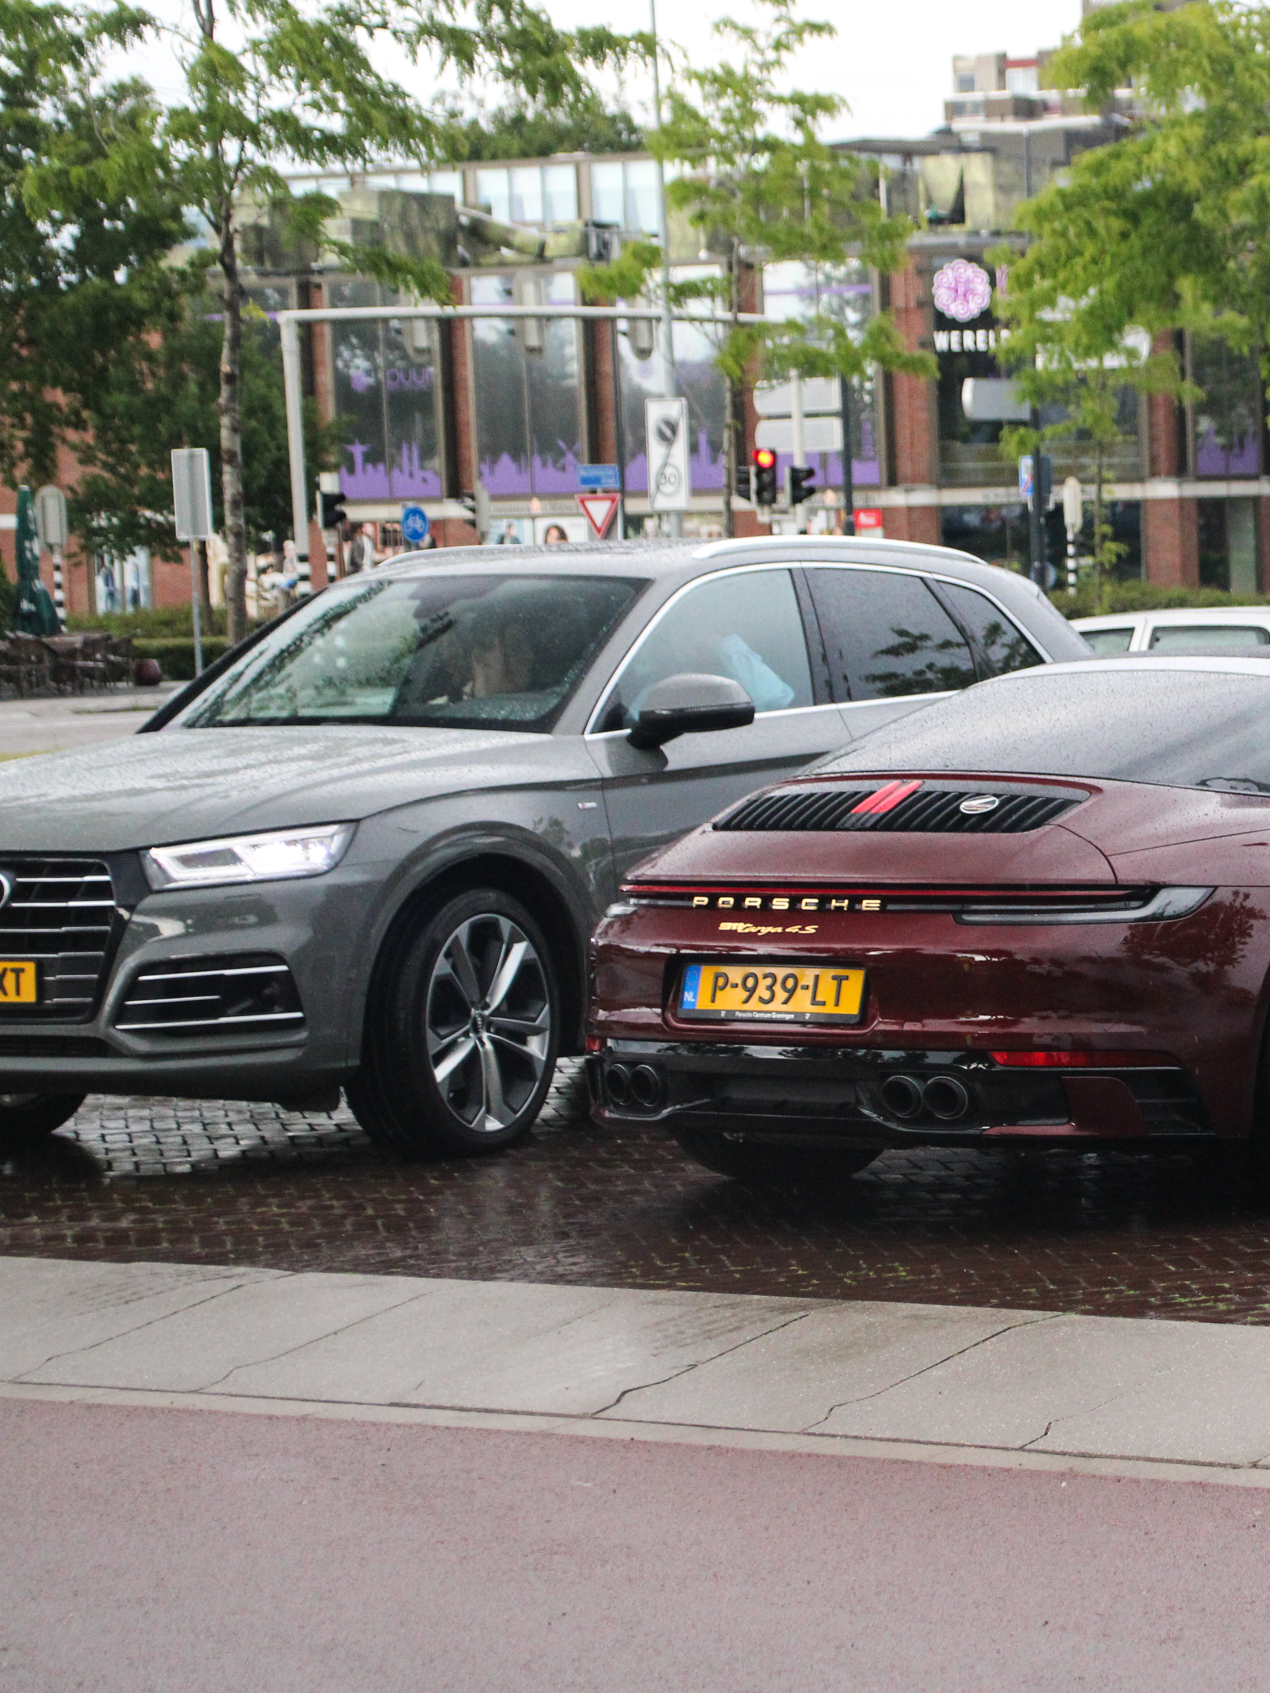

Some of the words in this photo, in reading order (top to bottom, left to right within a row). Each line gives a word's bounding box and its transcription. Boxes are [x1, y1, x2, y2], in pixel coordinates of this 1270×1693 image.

[692, 896, 881, 911] PORSCHE
[684, 991, 696, 1002] NL
[710, 971, 849, 1007] P-939-LT
